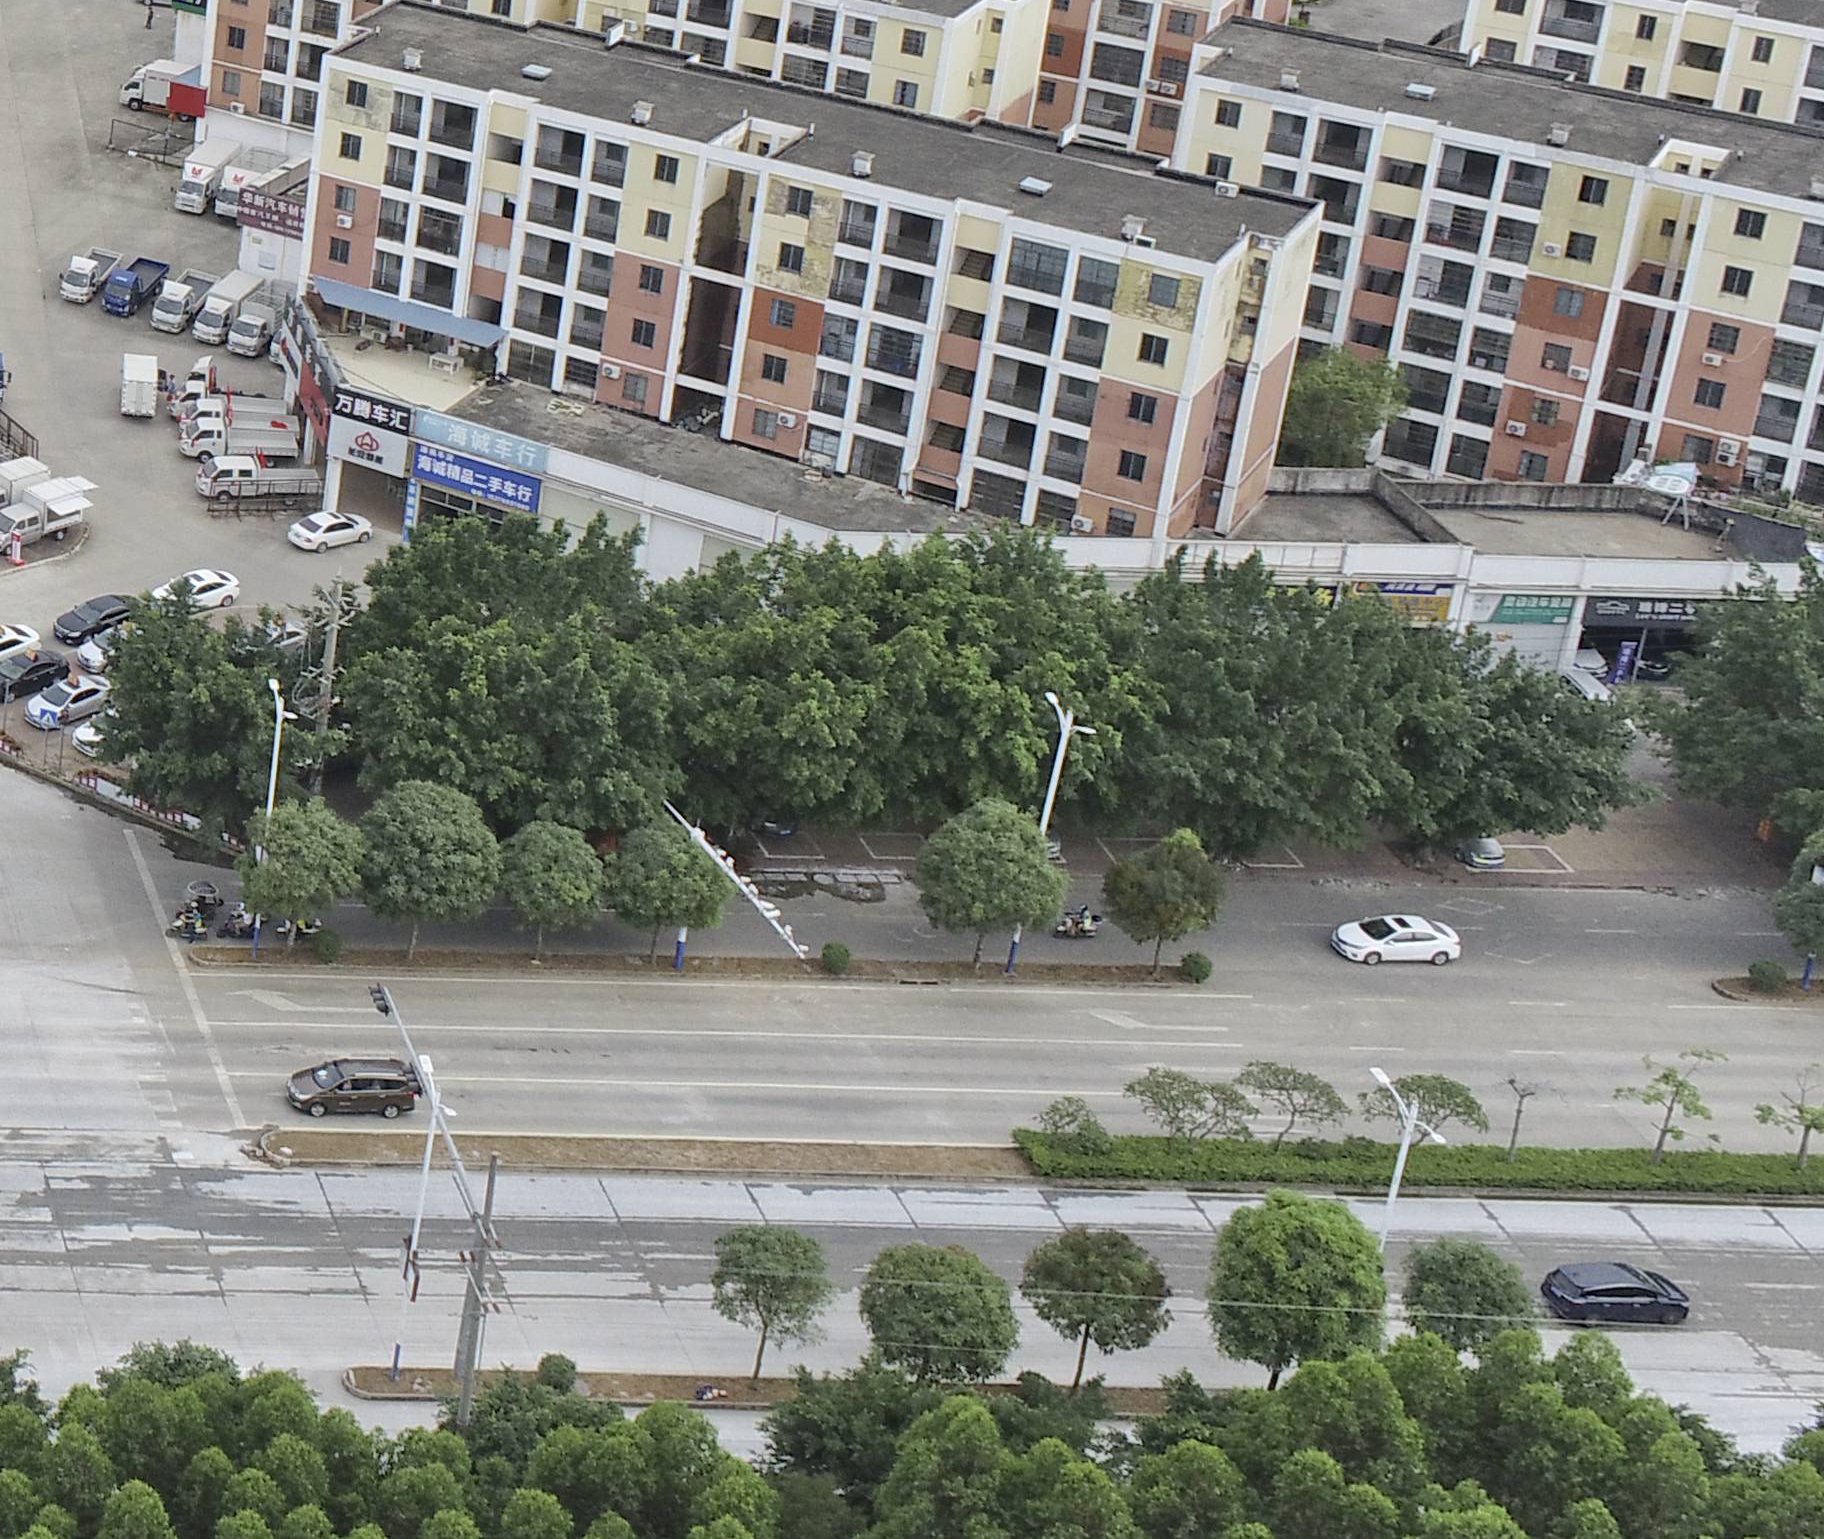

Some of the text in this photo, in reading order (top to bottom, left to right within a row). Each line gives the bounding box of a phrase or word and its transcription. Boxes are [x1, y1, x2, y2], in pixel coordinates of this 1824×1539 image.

[335, 392, 409, 431] 万腾车汇
[447, 423, 538, 468] 海诚车行
[416, 454, 533, 504] 海诚精品二手车行
